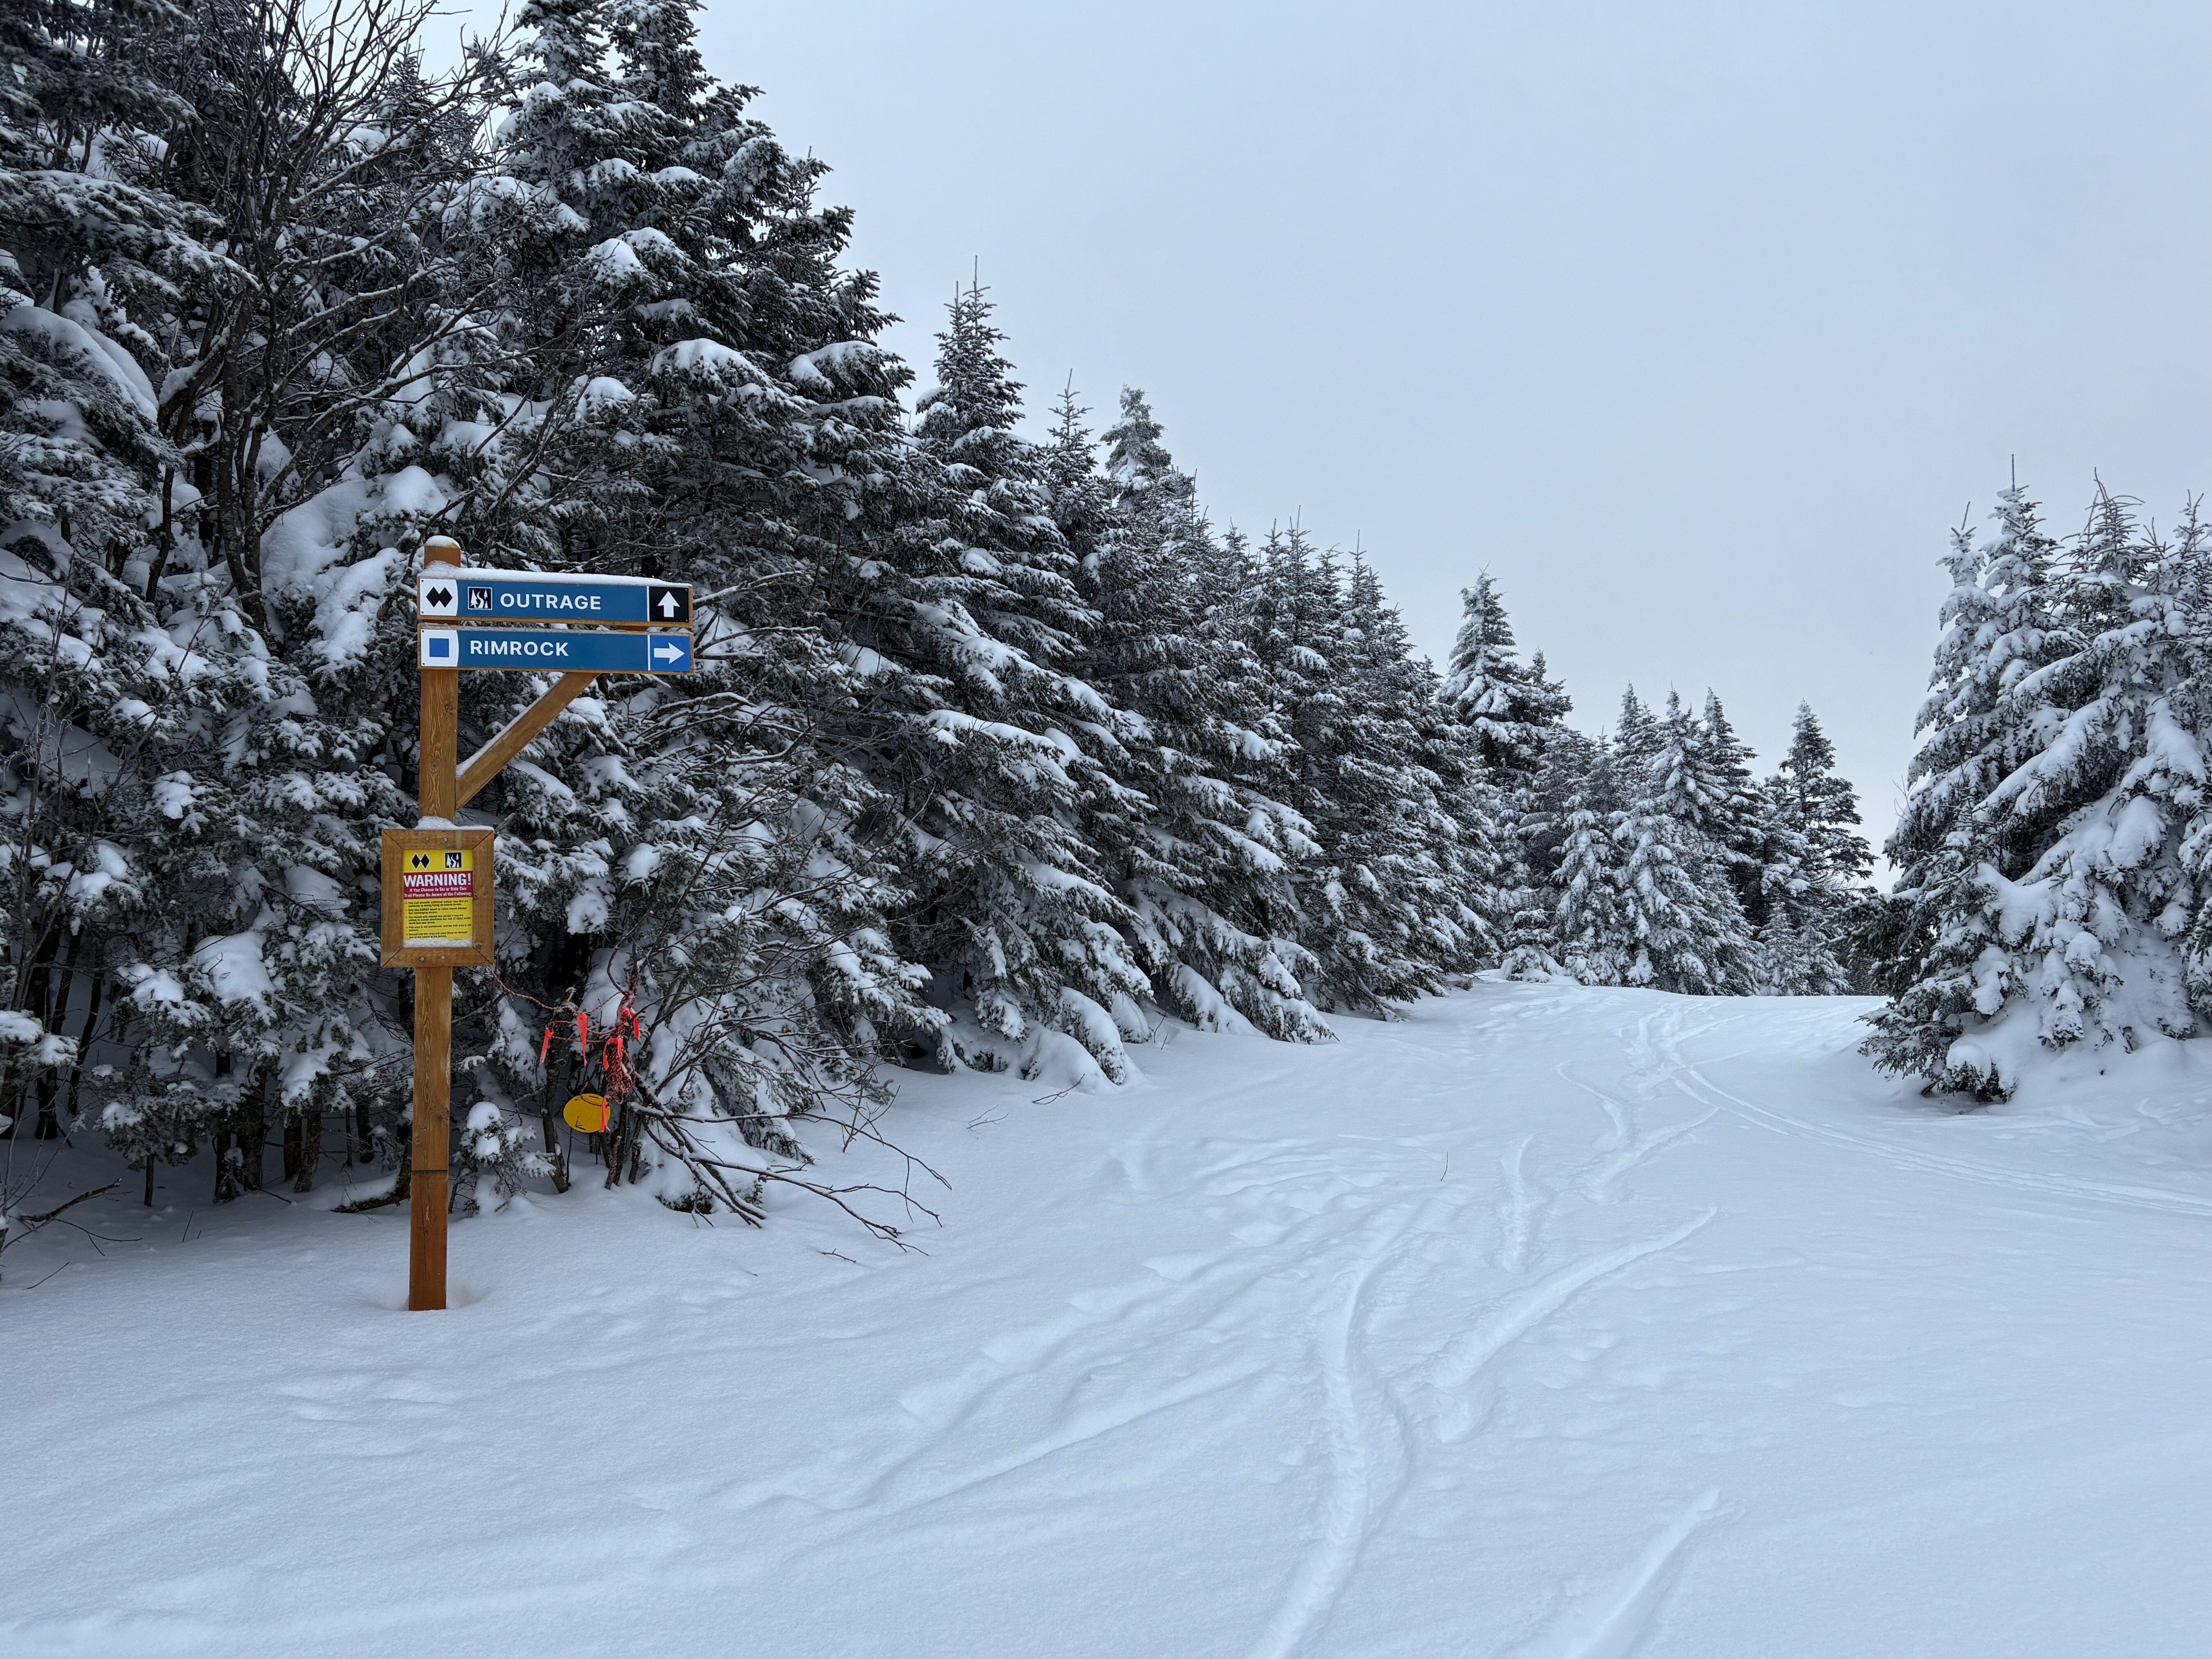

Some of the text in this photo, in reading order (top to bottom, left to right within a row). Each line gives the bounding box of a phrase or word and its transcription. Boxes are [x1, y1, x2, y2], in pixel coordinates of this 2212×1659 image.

[500, 593, 601, 610] OUTRAGE
[470, 640, 569, 656] RIMROCK
[403, 873, 471, 887] WARNING!
